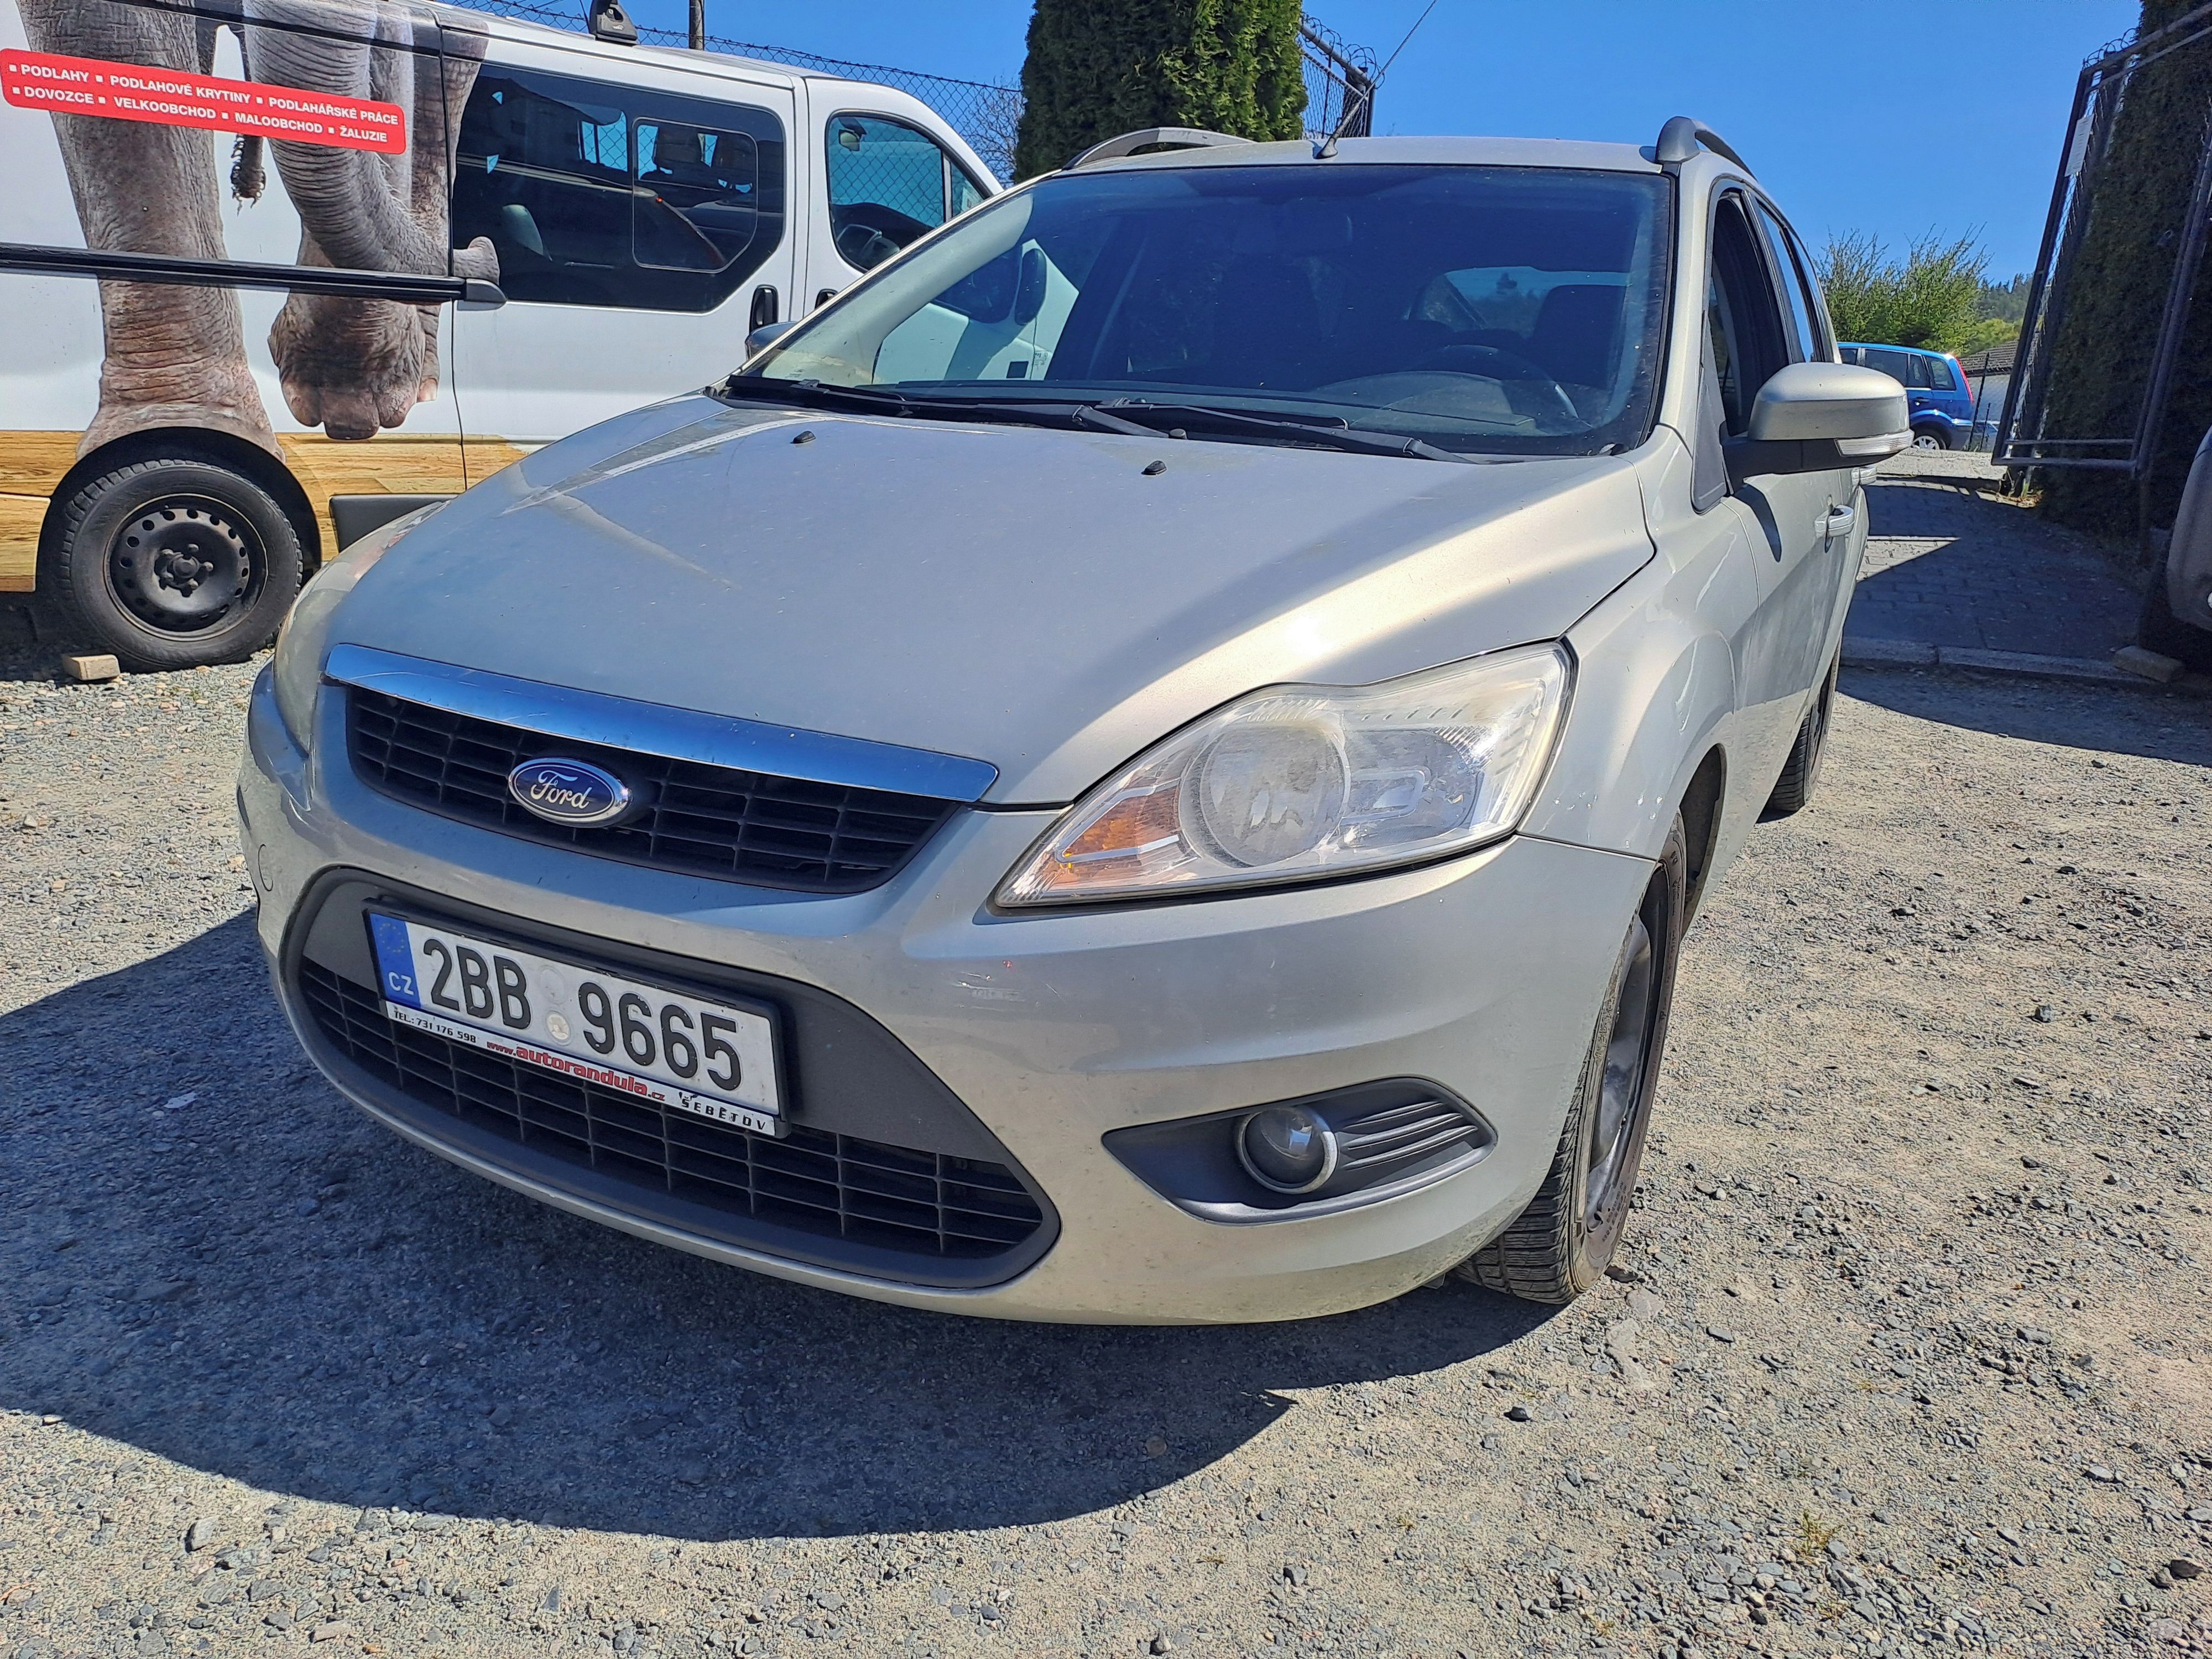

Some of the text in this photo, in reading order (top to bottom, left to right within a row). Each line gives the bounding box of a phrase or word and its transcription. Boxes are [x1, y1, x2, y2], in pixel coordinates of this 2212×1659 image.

[20, 64, 399, 125] PODLAHY PODLAHOVÉ KRYTINY PODLAHÁŘSKÉ PRÁCE
[24, 86, 388, 142] DOVOZCE VELKOOBCHOD MALOOBCHOD ŽALUZIE
[530, 770, 593, 809] Ford
[388, 971, 414, 996] CZ
[423, 938, 742, 1091] 2BB 9665
[436, 1024, 453, 1036] 176
[457, 1031, 477, 1044] 598
